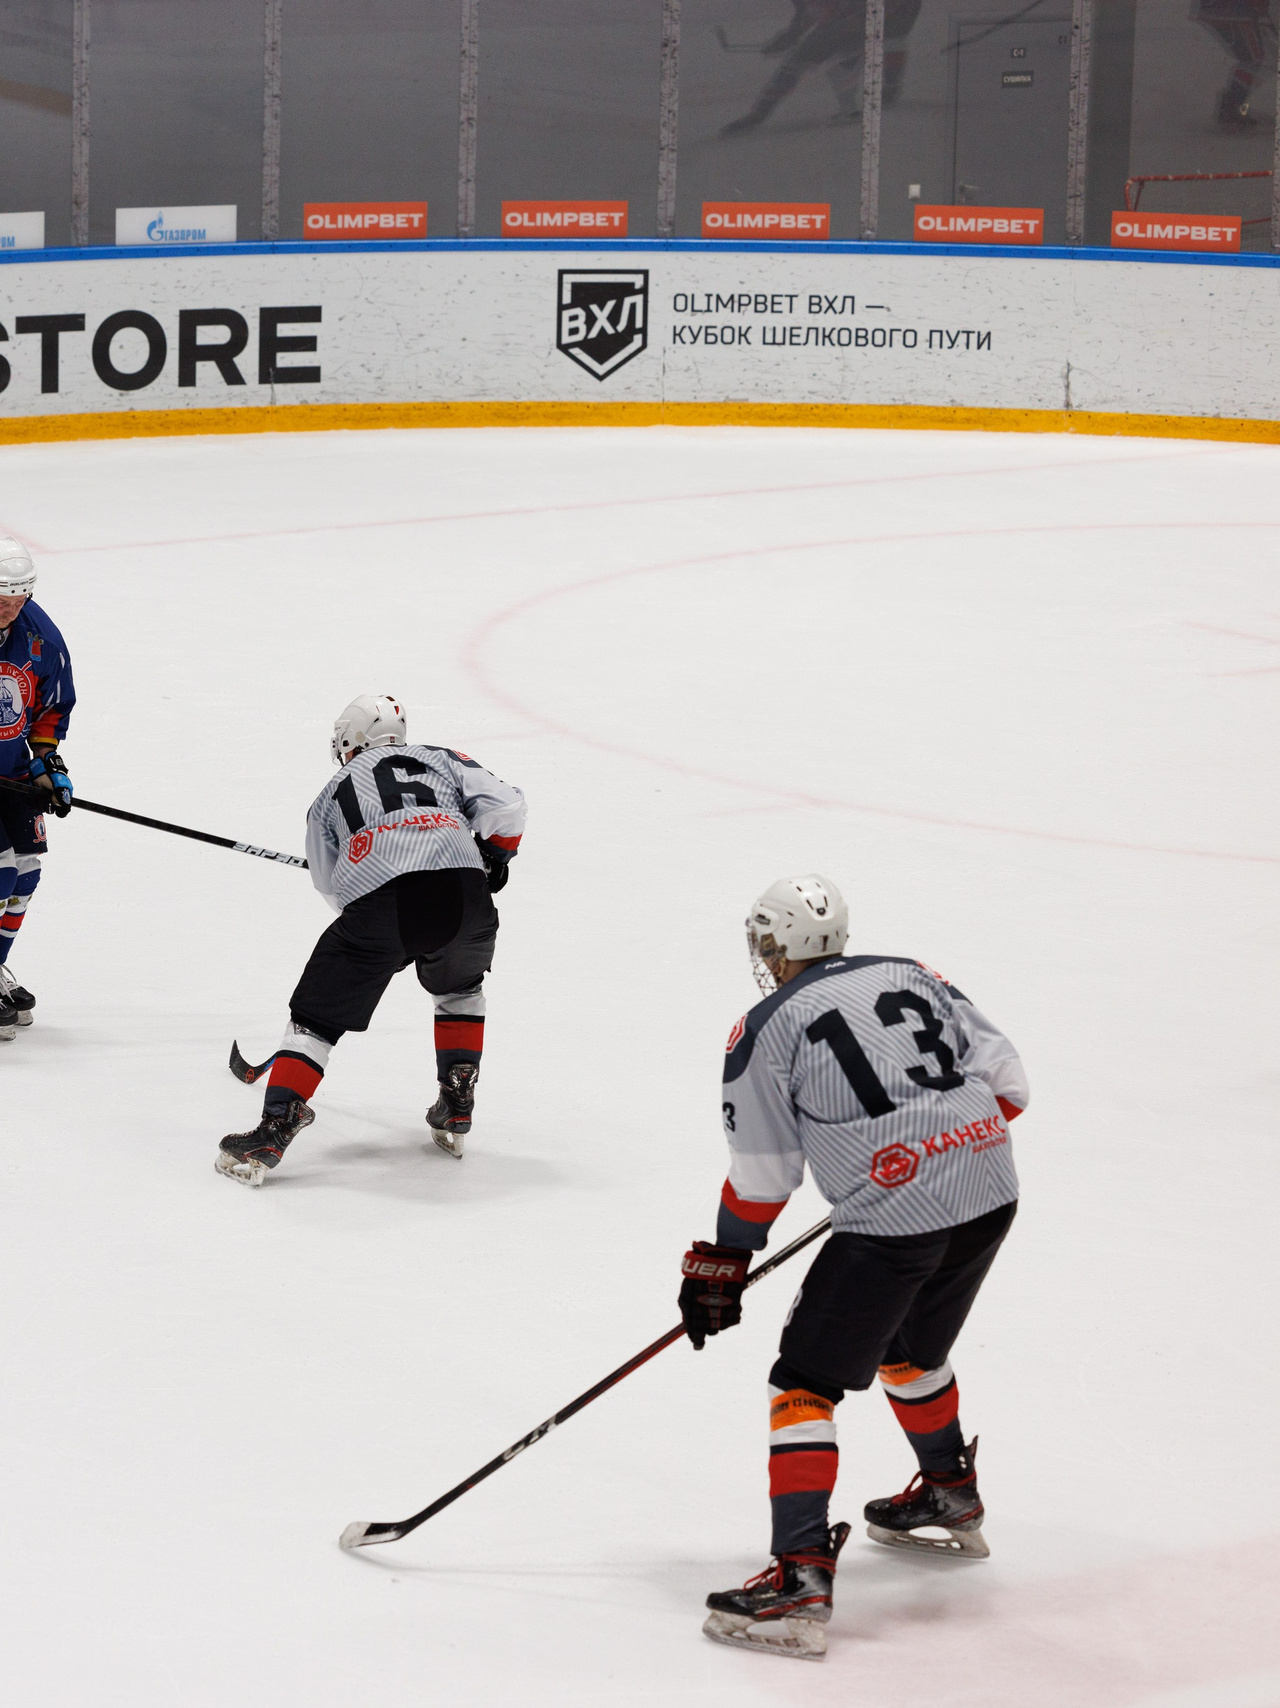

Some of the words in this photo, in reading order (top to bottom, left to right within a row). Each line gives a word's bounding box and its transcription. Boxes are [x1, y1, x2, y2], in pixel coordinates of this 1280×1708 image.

[306, 213, 424, 230] OLIMPBET
[504, 212, 624, 228] OLIMPBET
[704, 213, 826, 230] OLIMPBET
[917, 216, 1040, 235] OLIMPBET
[1114, 222, 1238, 242] OLIMPBET
[673, 293, 800, 314] OLIMPBET
[808, 295, 856, 316] ВХЛ
[560, 293, 644, 345] ВХЛ
[672, 325, 753, 346] КУБОК
[762, 326, 918, 349] ШЕЛКОВОГО
[928, 329, 992, 351] ПУТИ
[331, 754, 438, 834] 16
[805, 989, 966, 1120] 13
[920, 1114, 1007, 1158] КАНЕКС
